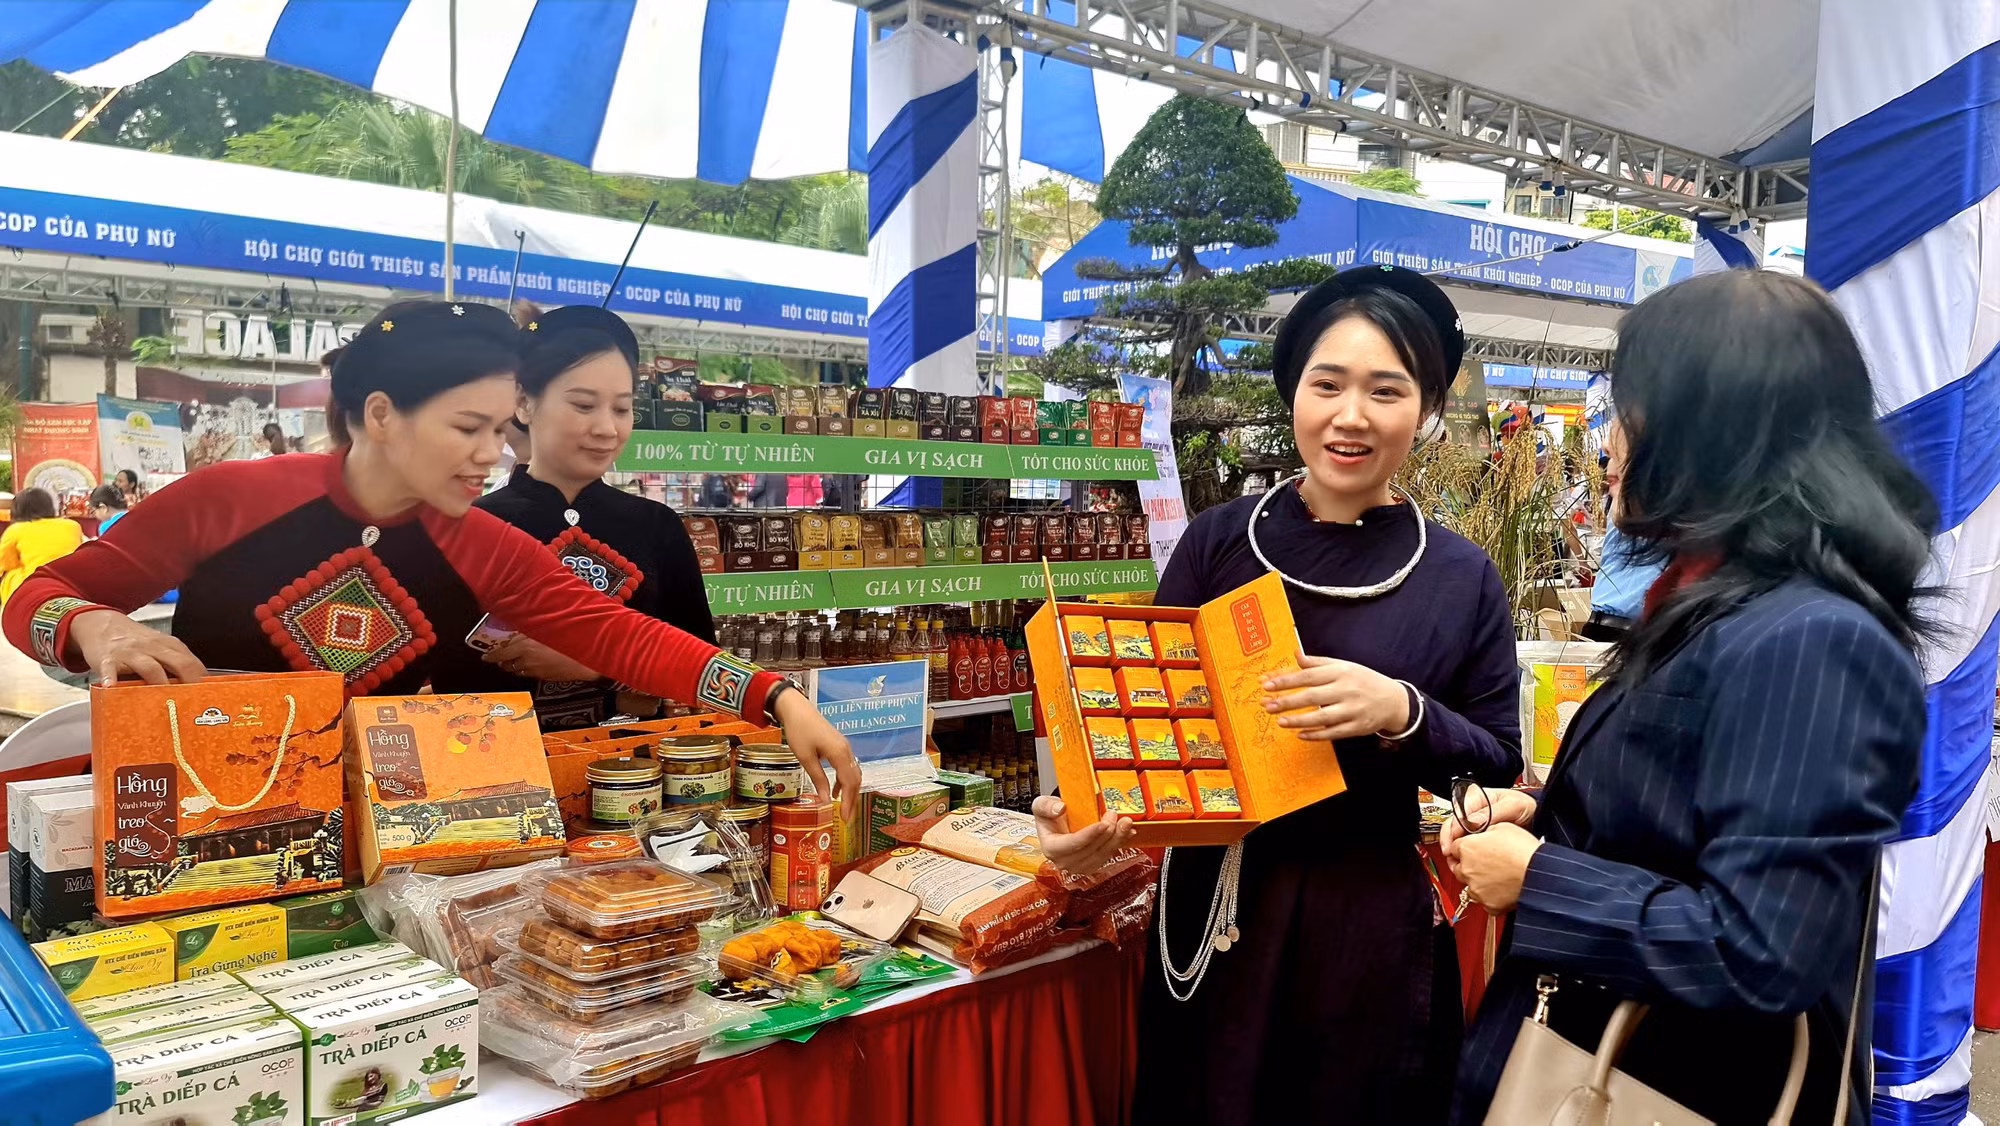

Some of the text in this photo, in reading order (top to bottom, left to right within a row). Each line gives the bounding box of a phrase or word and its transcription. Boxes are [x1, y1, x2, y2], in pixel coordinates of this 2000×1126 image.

[45, 214, 88, 239] CỦA
[95, 222, 139, 247] PHỤ
[147, 229, 177, 248] NỮ
[1470, 222, 1547, 266] HỘI CHỢ
[1336, 247, 1356, 265] NỮ
[244, 239, 278, 262] HỘI
[284, 244, 324, 267] CHỢ
[329, 249, 365, 269] GIỚI
[371, 256, 423, 277] THIỆU
[467, 264, 511, 286] PHẨM
[516, 271, 552, 291] KHỞI
[557, 278, 611, 300] NGHIỆP
[625, 286, 660, 303] OCOP
[665, 288, 691, 306] CỦA
[695, 293, 720, 311] PHỤ
[724, 295, 743, 312] NỮ
[1372, 249, 1394, 265] GIỚI
[1397, 253, 1428, 271] THIỆU
[1431, 257, 1451, 271] SẢN
[1484, 266, 1506, 282] KHỞI
[1508, 272, 1542, 289] NGHIỆP
[1551, 278, 1573, 292] OCOP
[1576, 279, 1592, 295] CỦA
[1594, 287, 1611, 300] PHỤ
[1614, 285, 1626, 299] NỮ
[1063, 288, 1080, 303] GIỚI
[781, 304, 853, 326] HỘI CHỢ GIỚI
[1016, 333, 1039, 347] OCOP
[1550, 369, 1567, 382] CHỢ
[634, 440, 815, 465] 100% TỪ TỰ NHIÊN
[864, 449, 984, 471] GIA VỊ SẠCH
[1021, 453, 1150, 472] TỐT CHO SỨC KHỎE
[865, 576, 982, 598] GIA VỊ SẠCH
[1019, 566, 1149, 589] TỐT CHO SỨC KHỎE
[724, 579, 814, 607] TỰ NHIÊN
[820, 694, 922, 717] HỘI LIÊN HIỆP PHỤ NỮ
[835, 713, 906, 731] TỈNH LẠNG SƠN
[368, 729, 409, 749] Hồng
[375, 762, 396, 772] treo
[117, 772, 167, 798] Hồng
[379, 776, 395, 790] gió
[117, 801, 138, 810] Vành
[118, 816, 145, 829] treo
[951, 815, 979, 832] Bún
[118, 834, 140, 853] gió
[392, 834, 405, 842] 500
[895, 855, 918, 871] Bún
[116, 955, 127, 963] CHẾ
[140, 950, 155, 959] NÔNG
[257, 951, 364, 980] TRÀ DIẾP CÁ
[189, 965, 209, 979] Trà
[287, 971, 394, 1001] TRÀ DIẾP CÁ
[313, 990, 423, 1021] TRÀ DIẾP CÁ
[445, 1013, 472, 1028] OCOP
[115, 1033, 239, 1068] TRÀ DIẾP CÁ
[320, 1025, 428, 1065] TRÀ DIẾP CÁ
[261, 1057, 295, 1073] OCOP
[114, 1070, 240, 1115] TRÀ DIẾP CÁ
